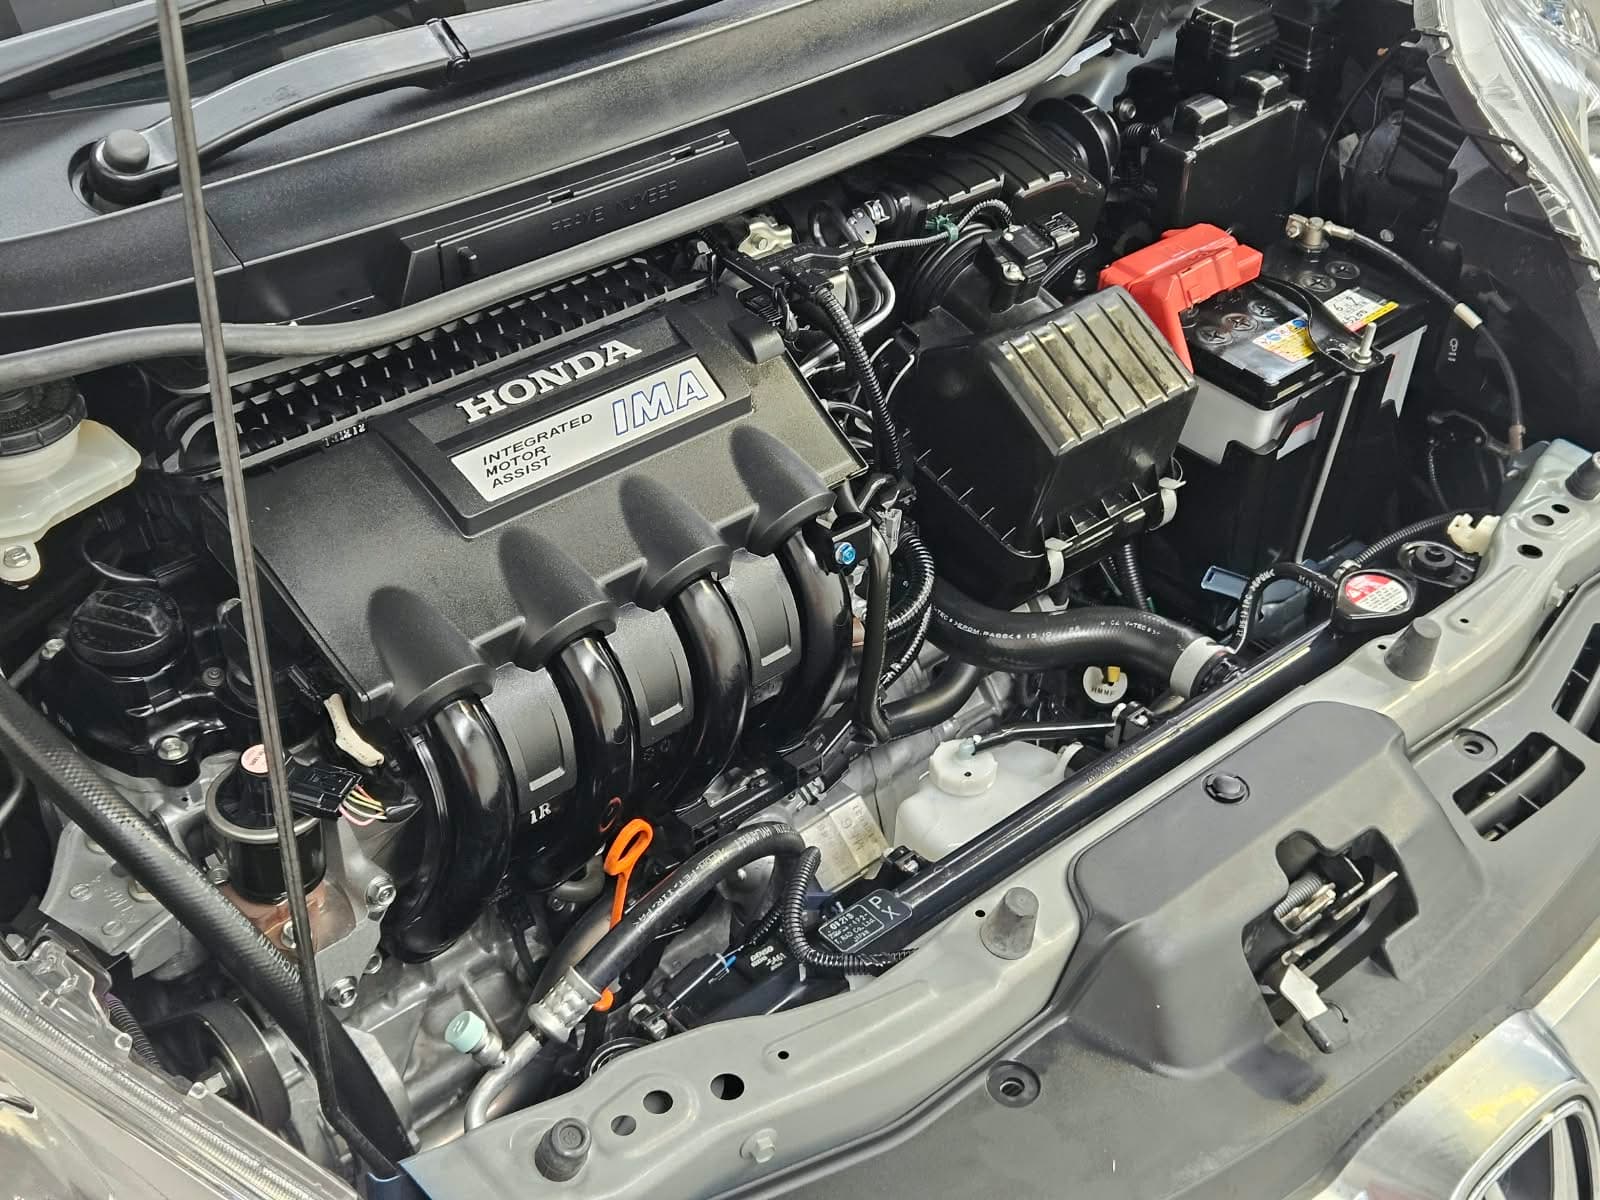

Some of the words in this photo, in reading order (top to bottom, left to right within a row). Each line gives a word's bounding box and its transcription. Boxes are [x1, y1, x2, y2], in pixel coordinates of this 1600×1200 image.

[455, 338, 643, 424] HONDA
[482, 412, 594, 466] INTEGRATED
[611, 369, 710, 437] IMA
[485, 445, 548, 478] MOTOR
[491, 455, 553, 490] ASSIST
